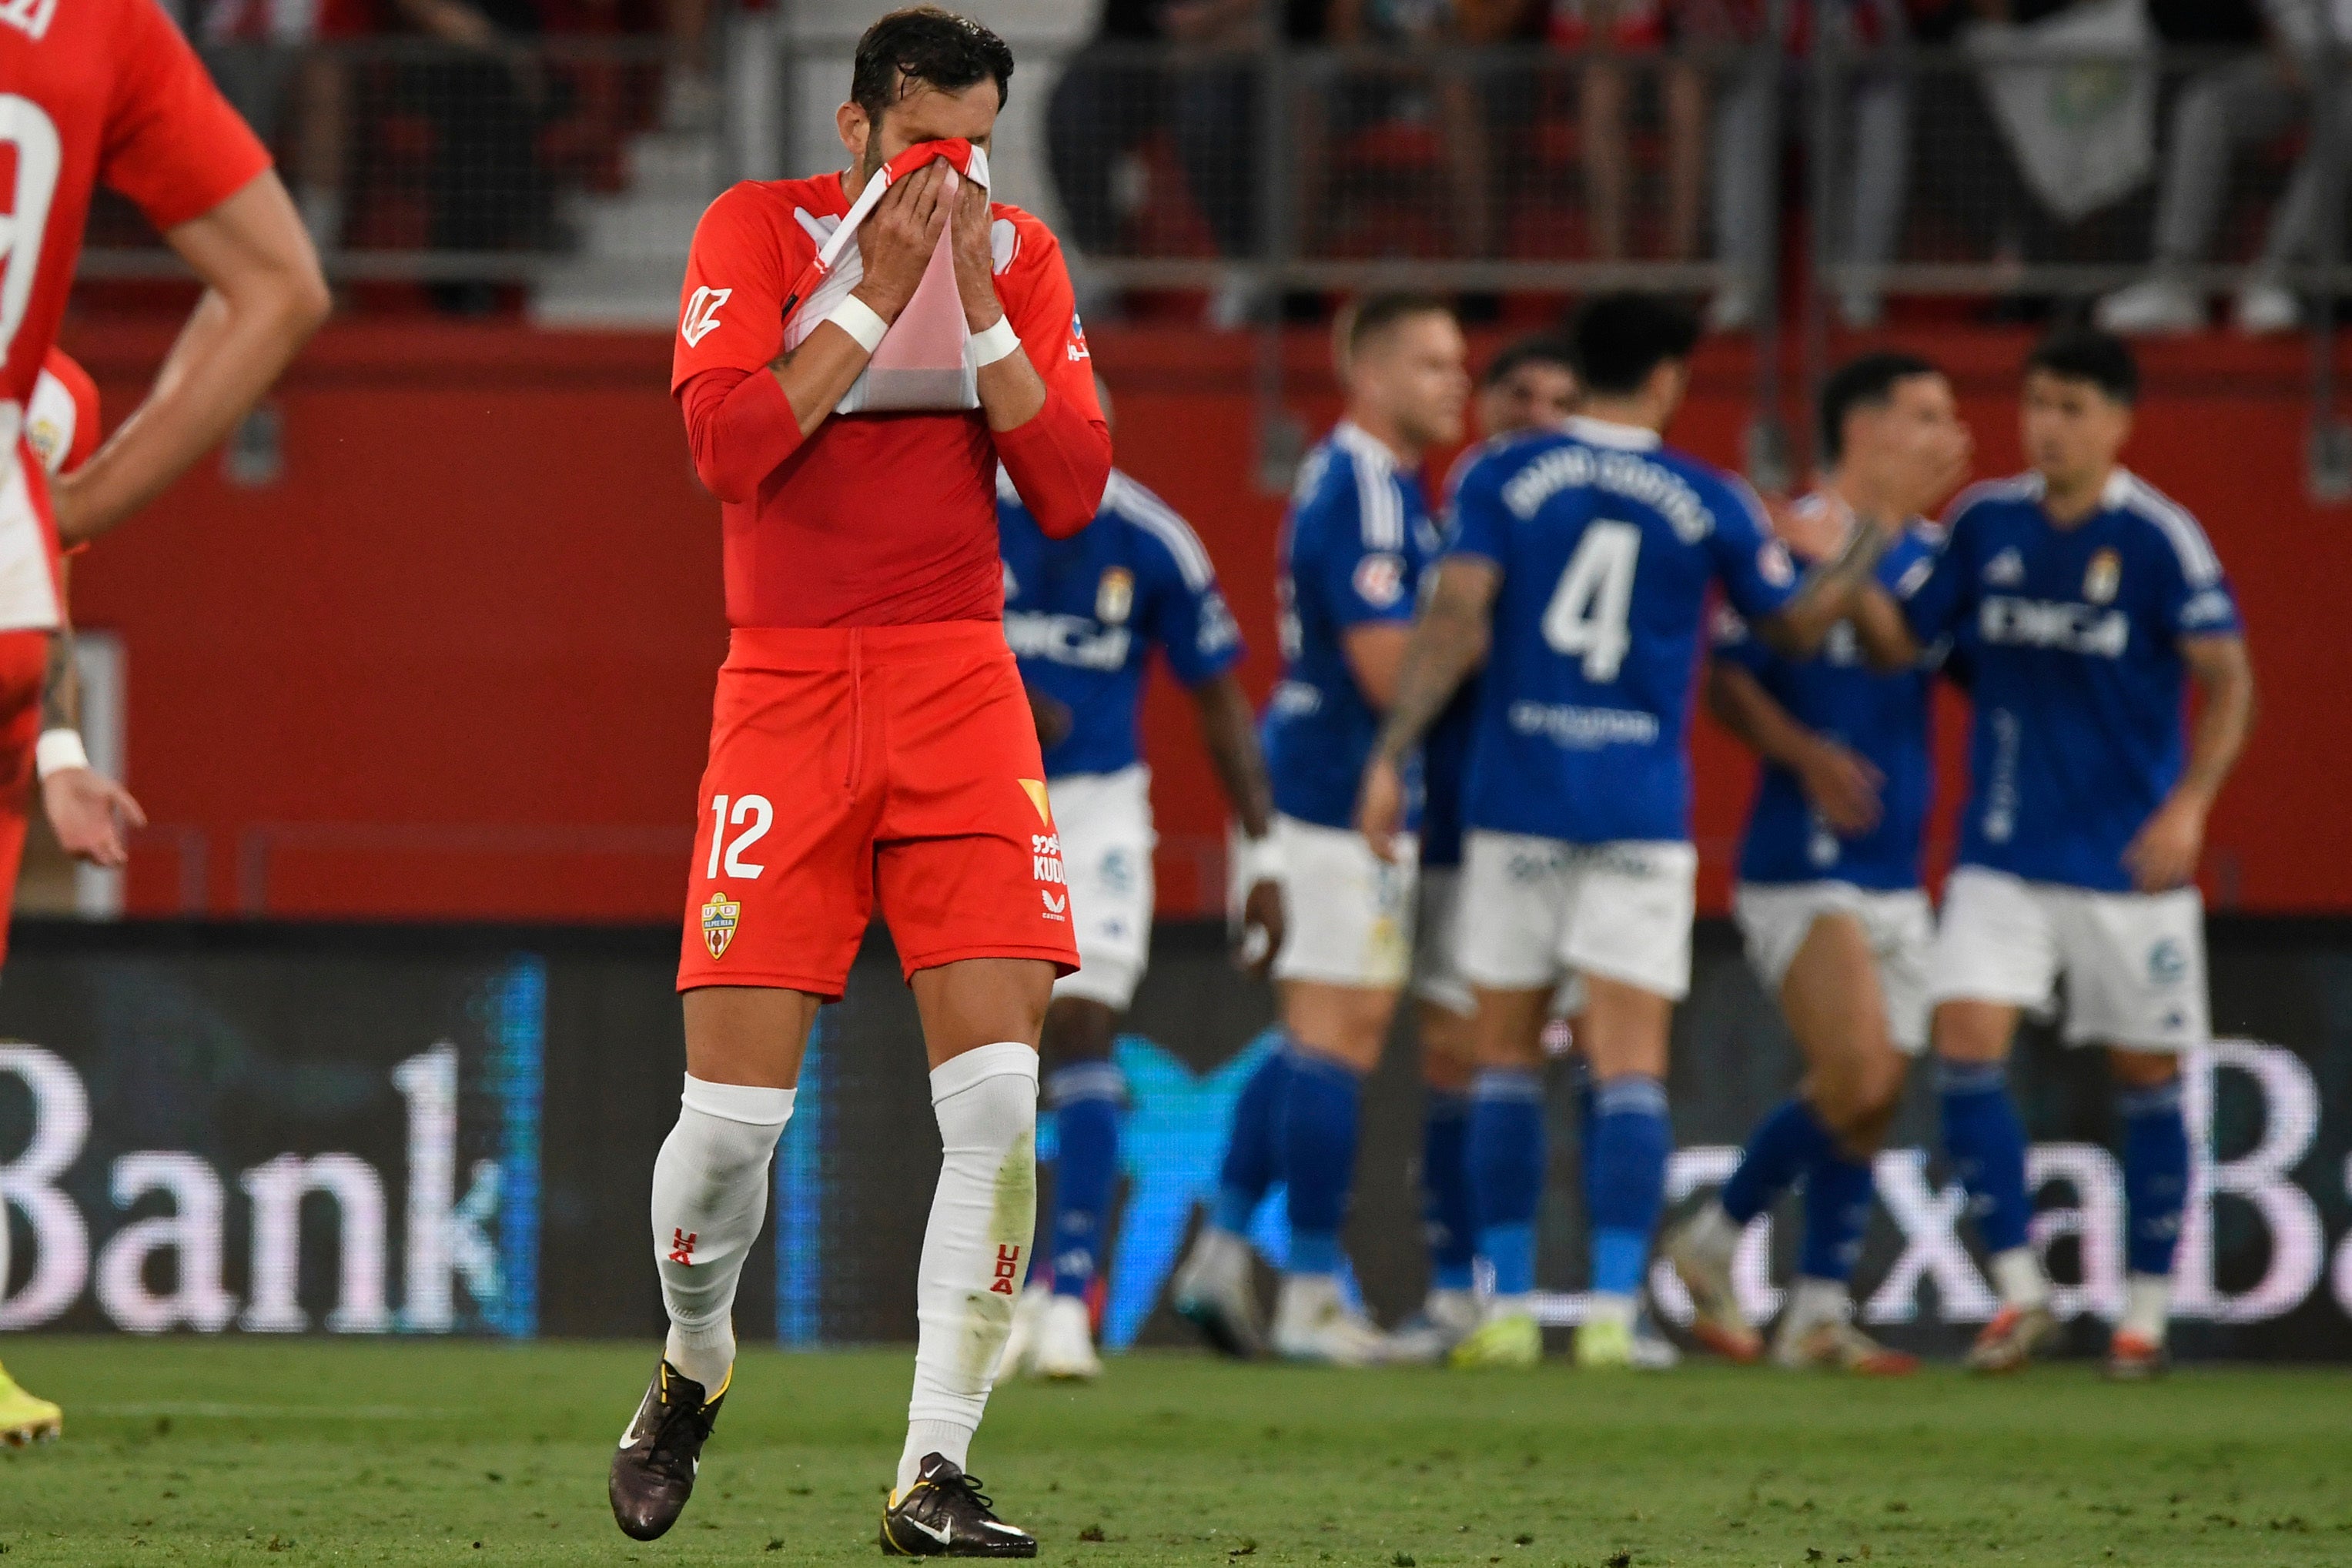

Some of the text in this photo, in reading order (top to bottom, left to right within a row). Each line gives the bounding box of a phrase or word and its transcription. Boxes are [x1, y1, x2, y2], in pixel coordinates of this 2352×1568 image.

[1541, 517, 1643, 684] 4
[706, 794, 774, 879] 12
[989, 1244, 1019, 1295] UDA
